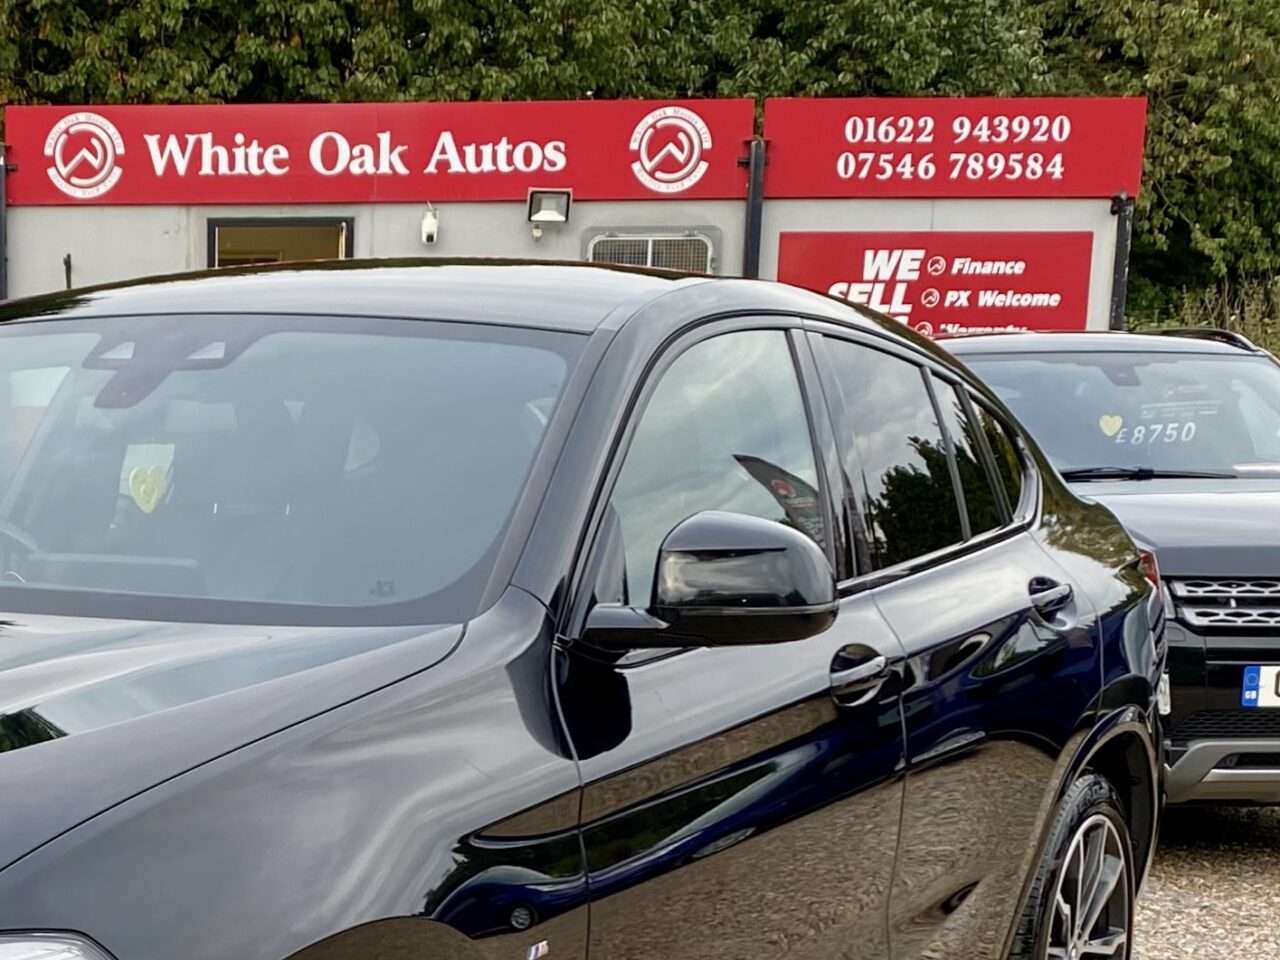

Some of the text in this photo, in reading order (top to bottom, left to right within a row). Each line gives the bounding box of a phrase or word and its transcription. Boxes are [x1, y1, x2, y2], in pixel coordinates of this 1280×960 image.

[845, 116, 1070, 143] 01622 943920
[144, 131, 566, 176] White Oak Autos
[837, 153, 1064, 179] 07546 789584
[862, 250, 925, 281] WE
[952, 258, 1025, 274] Finance
[944, 291, 1060, 306] PX Welcome
[1115, 422, 1196, 445] £8750
